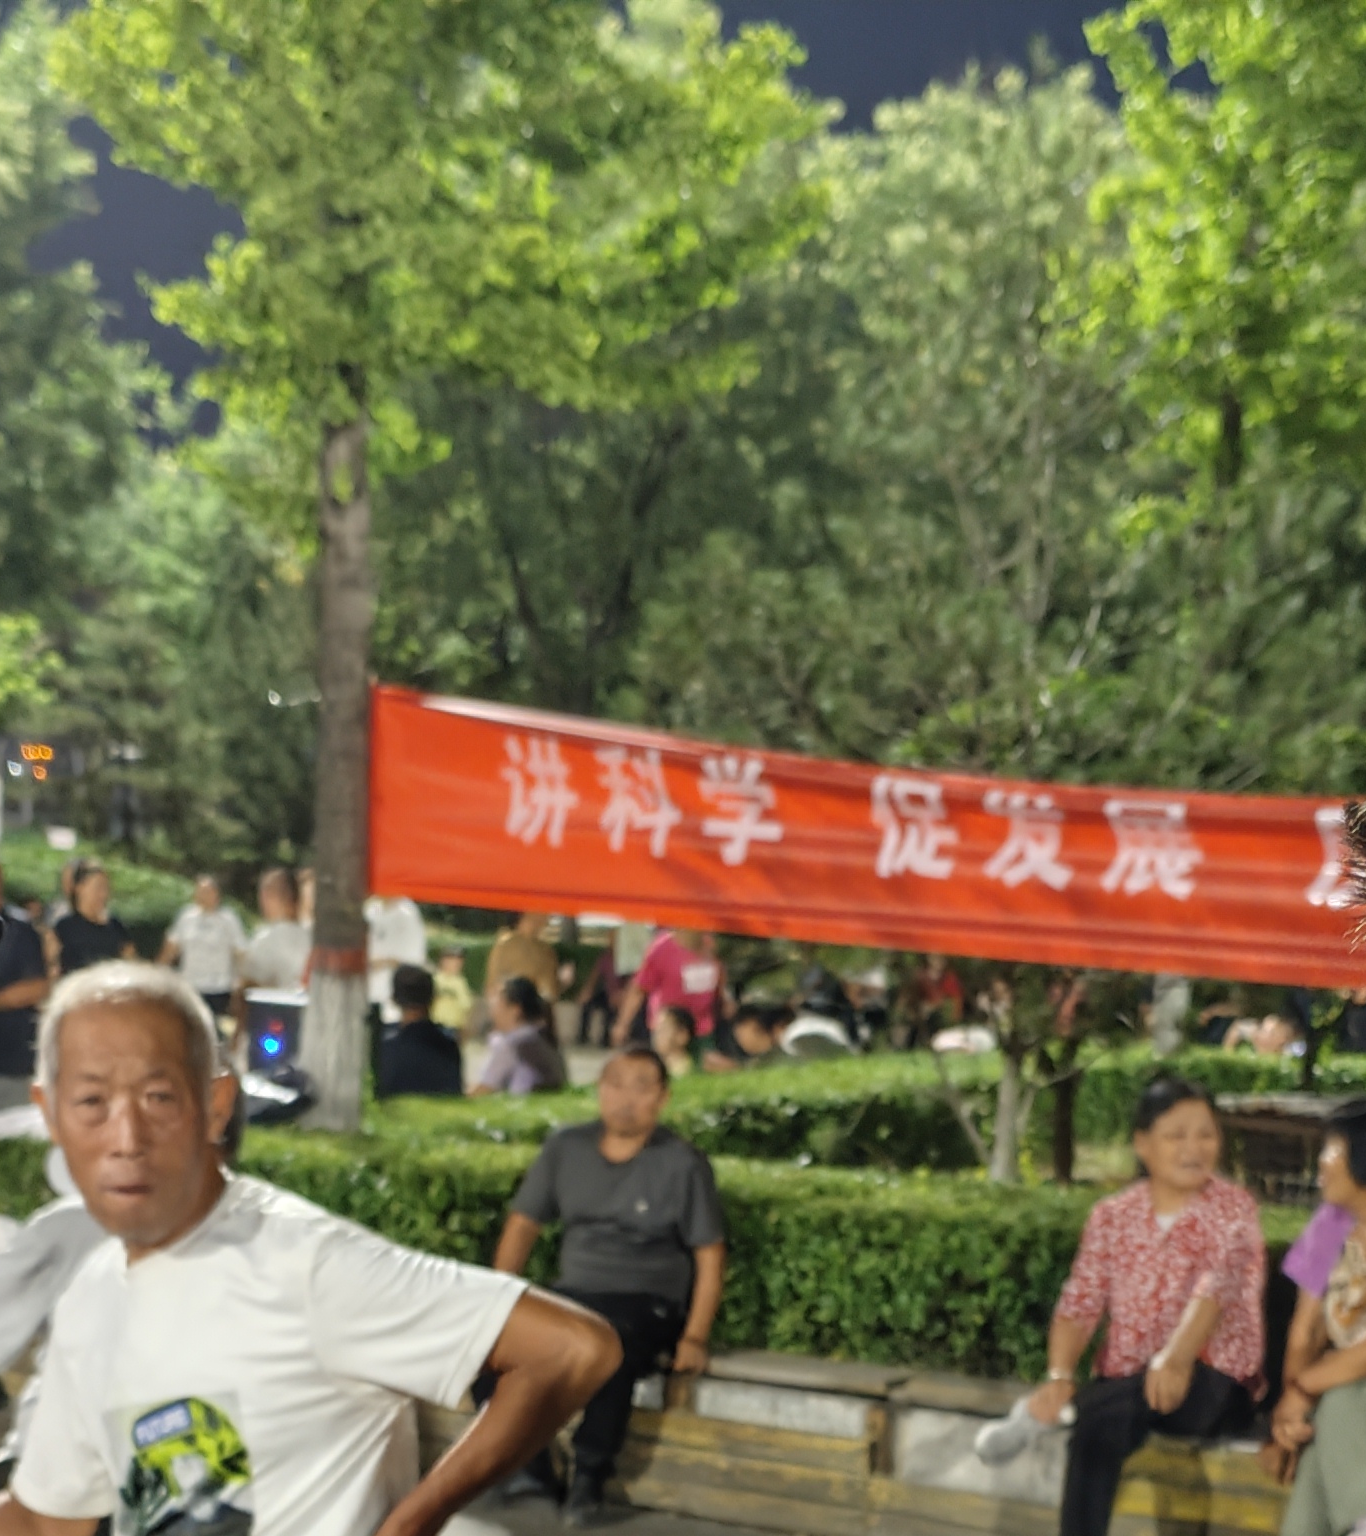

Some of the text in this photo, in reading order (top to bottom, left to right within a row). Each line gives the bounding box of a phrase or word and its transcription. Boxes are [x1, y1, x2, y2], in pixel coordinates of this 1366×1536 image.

[500, 733, 785, 866] 讲科学
[870, 774, 1205, 901] 促发展
